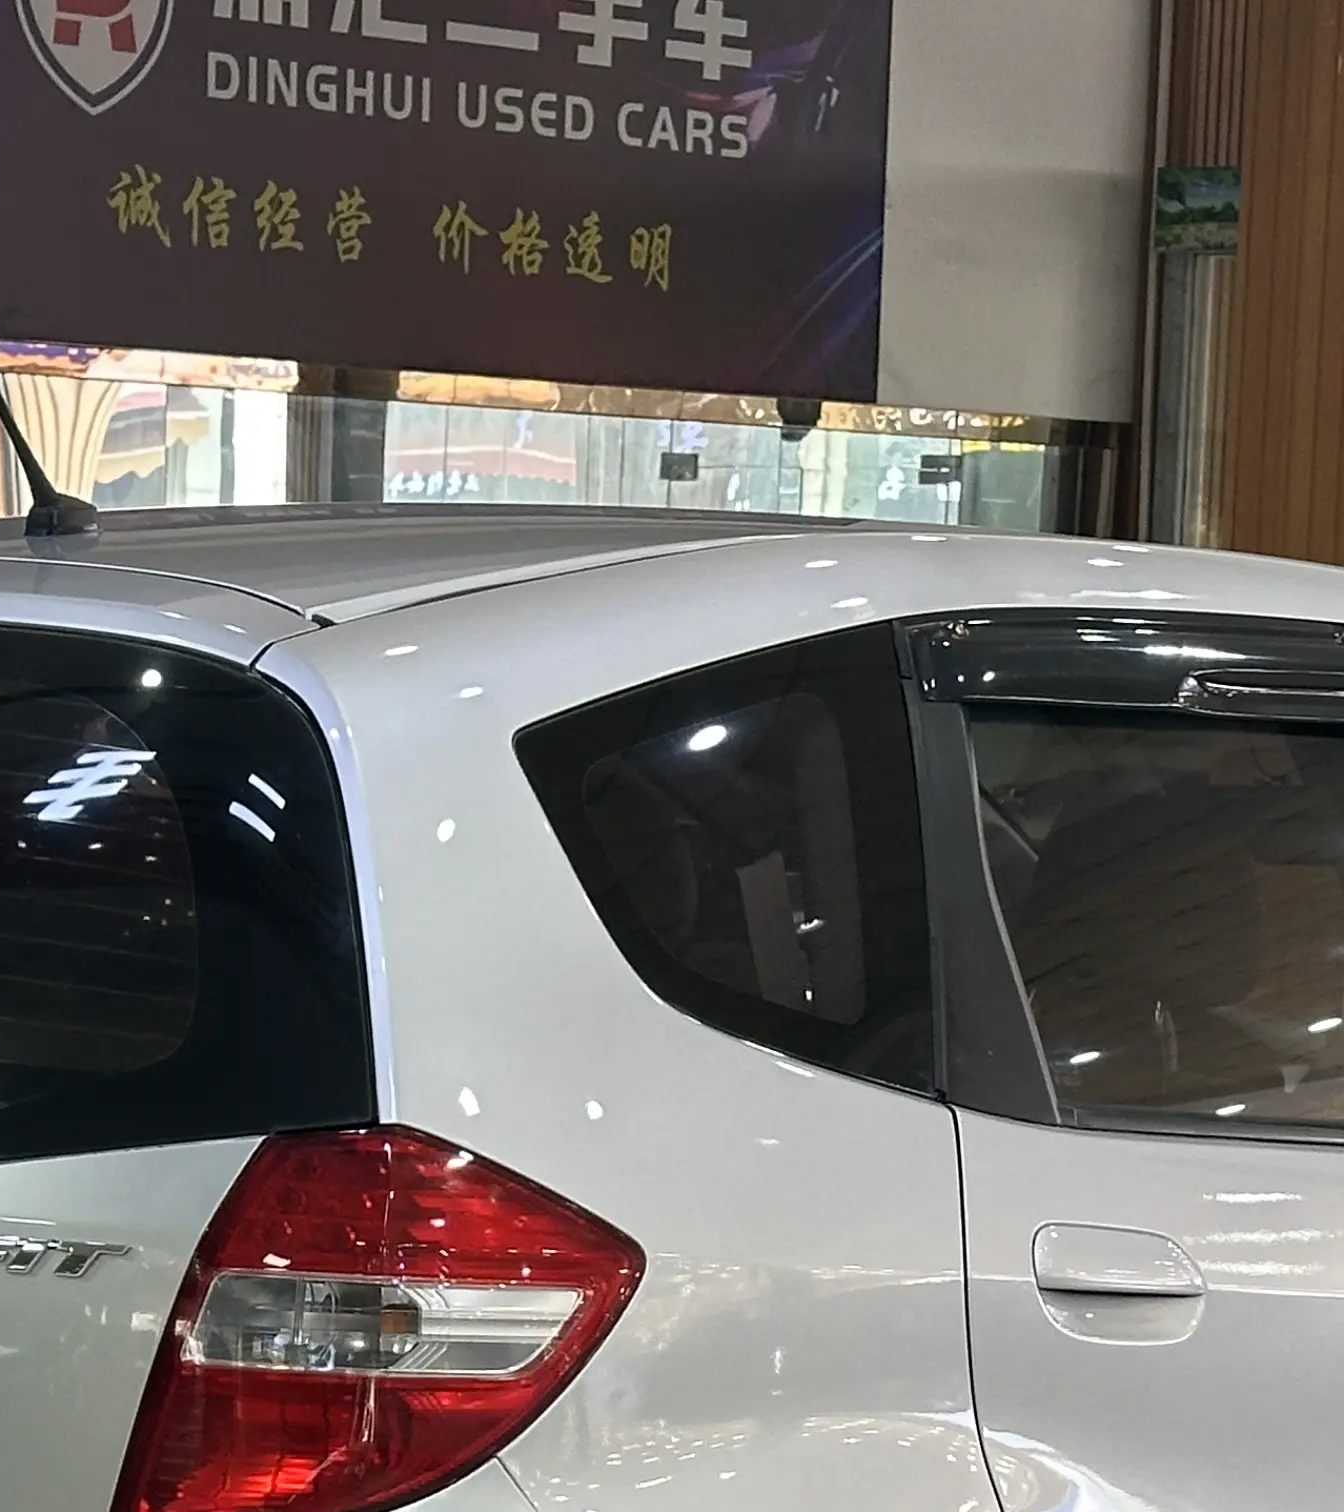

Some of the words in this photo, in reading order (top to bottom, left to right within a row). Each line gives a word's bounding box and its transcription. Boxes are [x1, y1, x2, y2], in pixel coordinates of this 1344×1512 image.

[207, 51, 431, 124] DINGHUI
[458, 82, 594, 142] USED
[617, 102, 749, 158] CARS
[107, 164, 372, 264] 诚信经营
[432, 200, 673, 292] 价格透明
